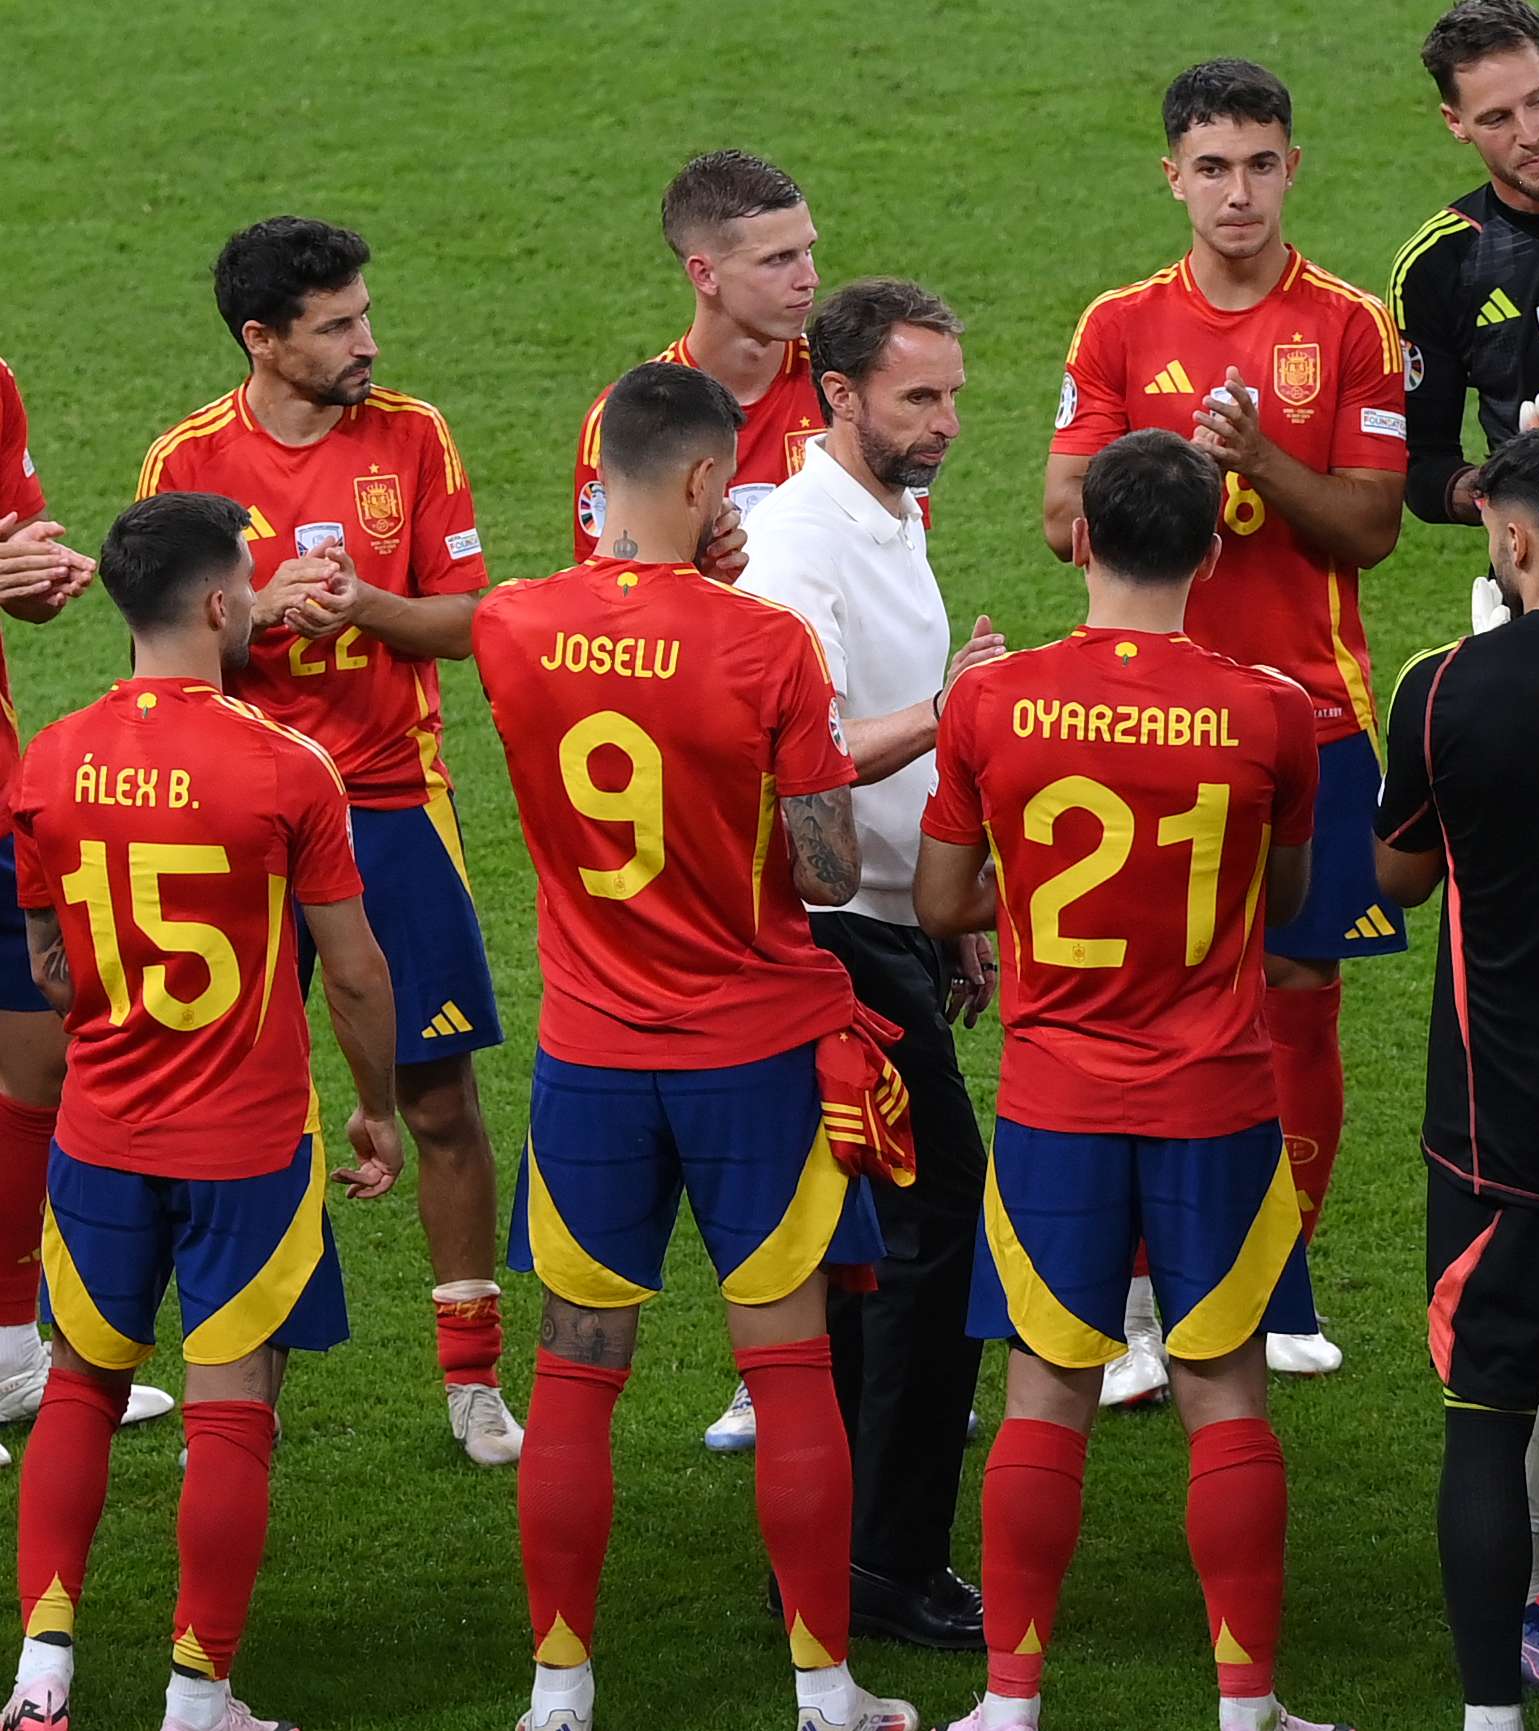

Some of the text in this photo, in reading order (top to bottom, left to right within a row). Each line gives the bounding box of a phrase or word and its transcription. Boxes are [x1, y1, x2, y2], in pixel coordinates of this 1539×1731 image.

[540, 631, 680, 680] JOSELU
[75, 752, 200, 810] ÁLEX B.
[1012, 697, 1240, 748] OYARZABAL
[559, 710, 667, 901] 9
[1023, 774, 1231, 970] 21
[62, 839, 242, 1032] 15
